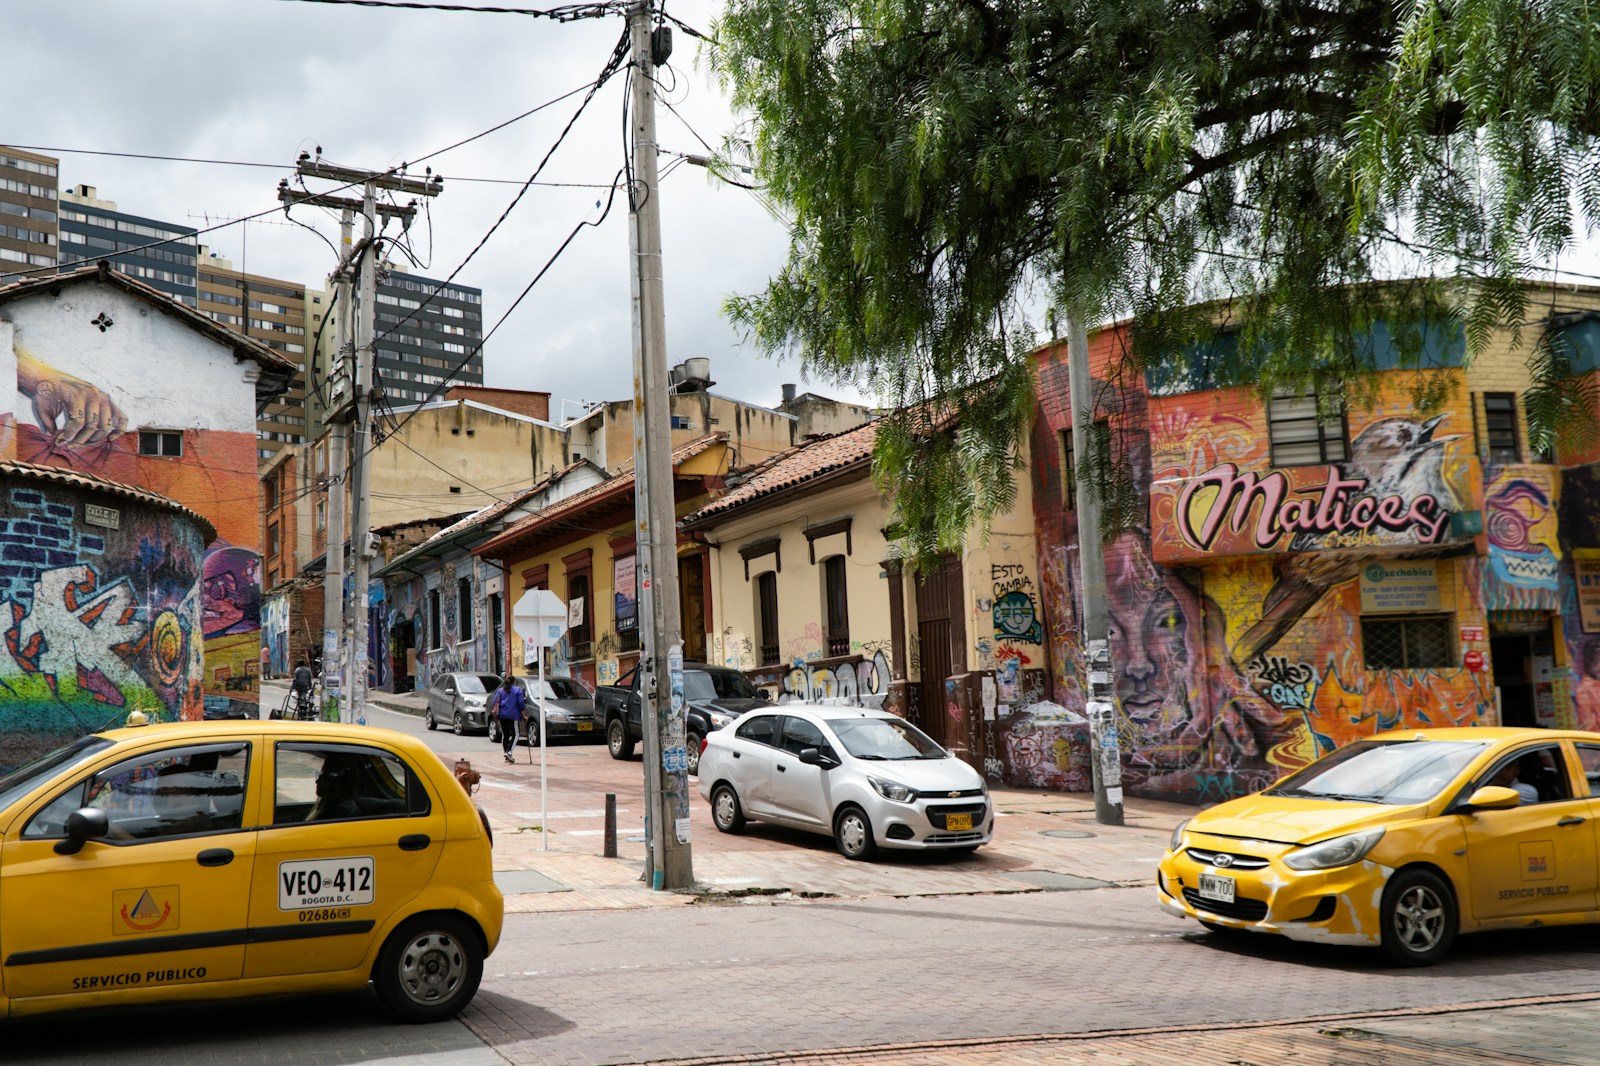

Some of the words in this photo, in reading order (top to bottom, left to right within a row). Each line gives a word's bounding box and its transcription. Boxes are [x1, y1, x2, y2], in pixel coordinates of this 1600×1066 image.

[1177, 463, 1449, 550] Matices
[992, 564, 1024, 580] ESTO
[282, 870, 321, 896] VEO
[333, 866, 371, 892] 412
[301, 896, 335, 905] BOGOTA
[1498, 888, 1535, 900] SERVICIO
[1536, 885, 1569, 896] PUBLICO
[299, 908, 337, 922] 02686
[72, 973, 141, 989] SERVICIO
[146, 967, 207, 982] PUBLICO
